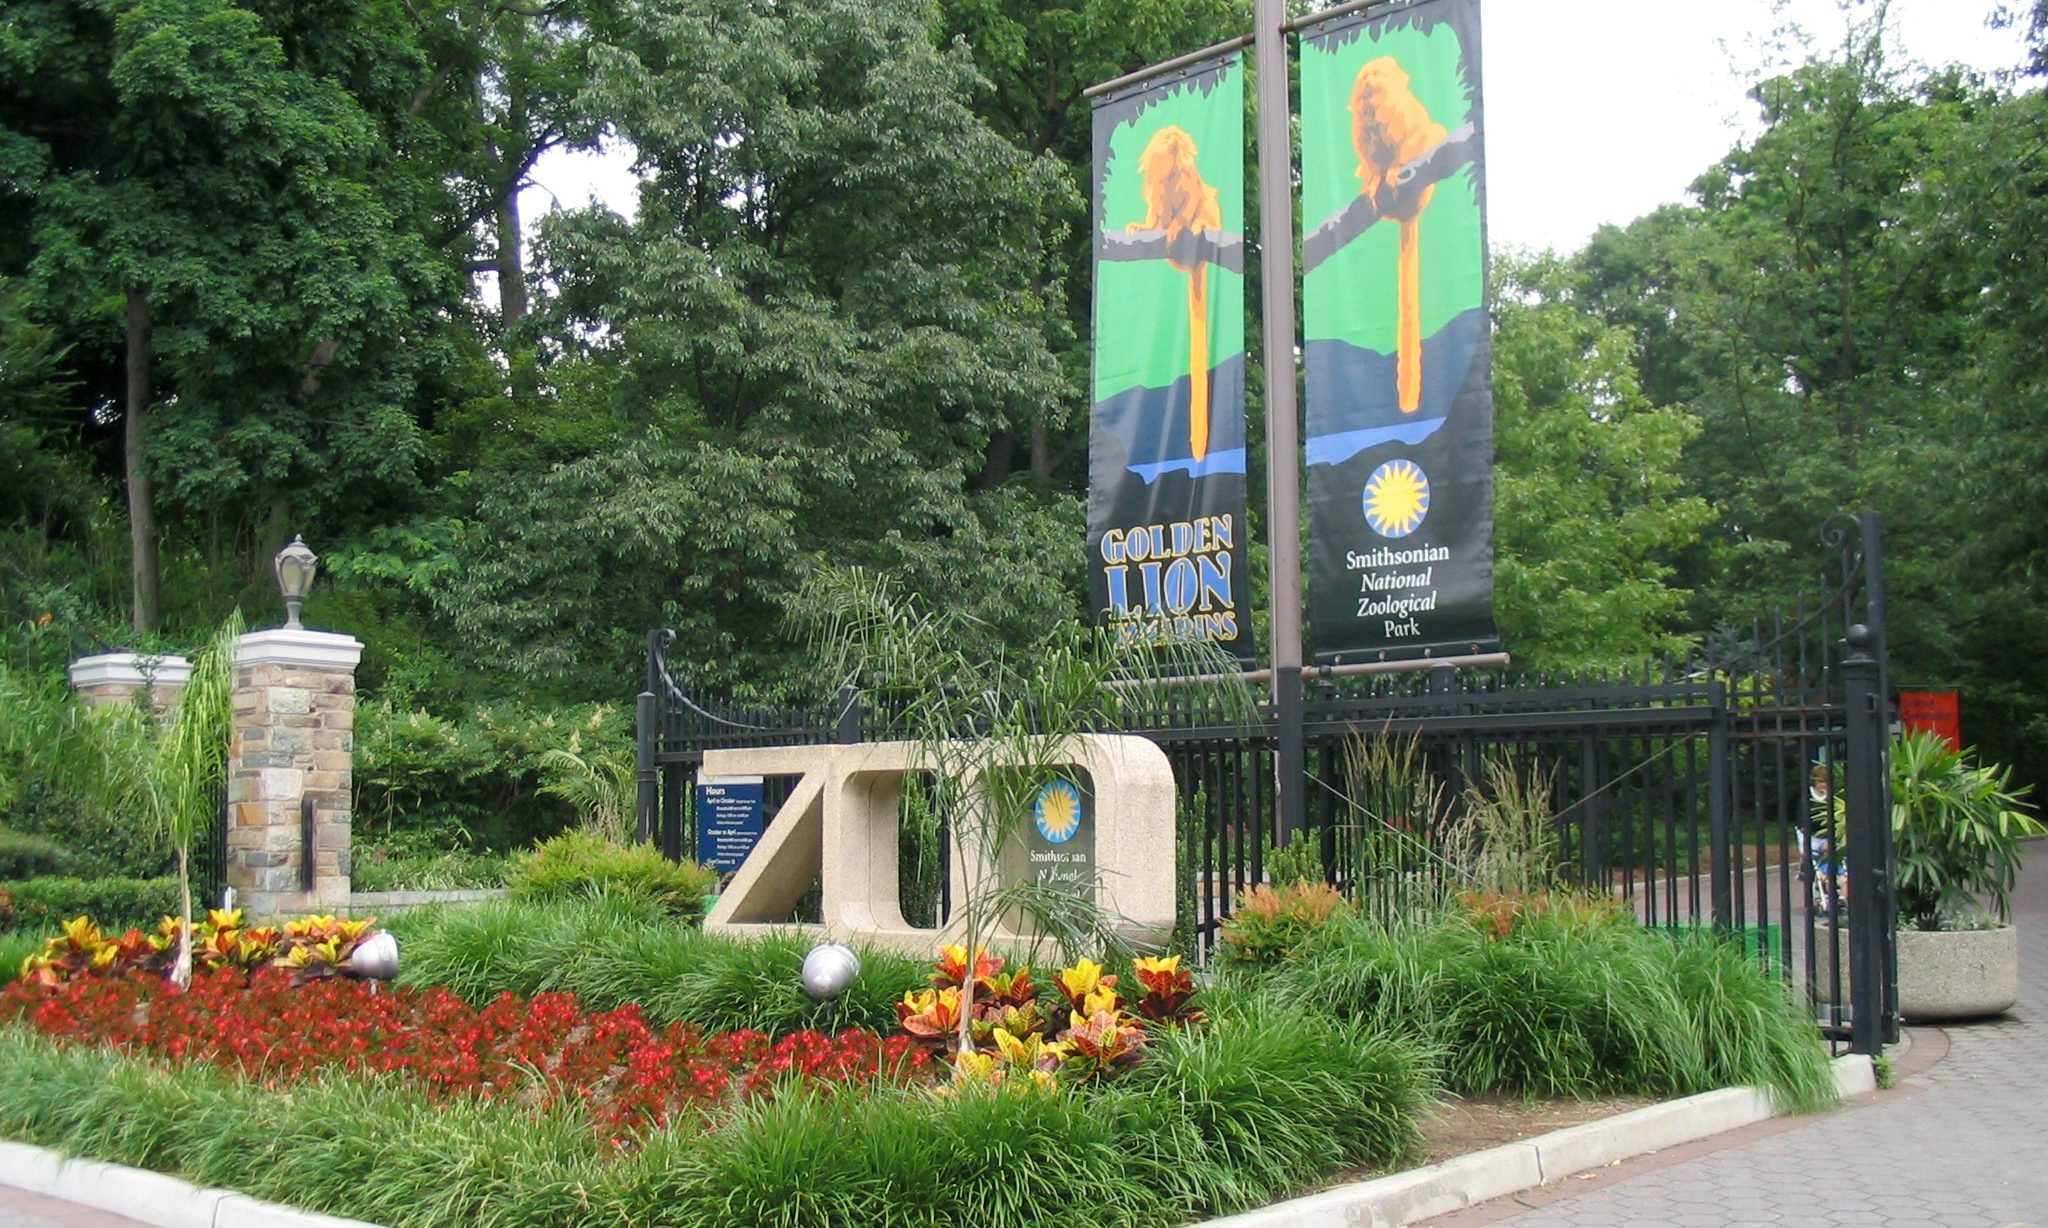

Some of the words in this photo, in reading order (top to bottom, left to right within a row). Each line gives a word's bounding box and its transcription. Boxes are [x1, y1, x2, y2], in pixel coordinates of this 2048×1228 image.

[1101, 514, 1234, 564] GOLDEN
[1346, 543, 1450, 570] Smithsonian
[1104, 551, 1235, 620] LION
[1360, 566, 1432, 592] National
[1356, 590, 1437, 618] Zoological
[1384, 617, 1421, 638] Park
[705, 786, 726, 796] Hours
[703, 733, 1177, 950] ZOO
